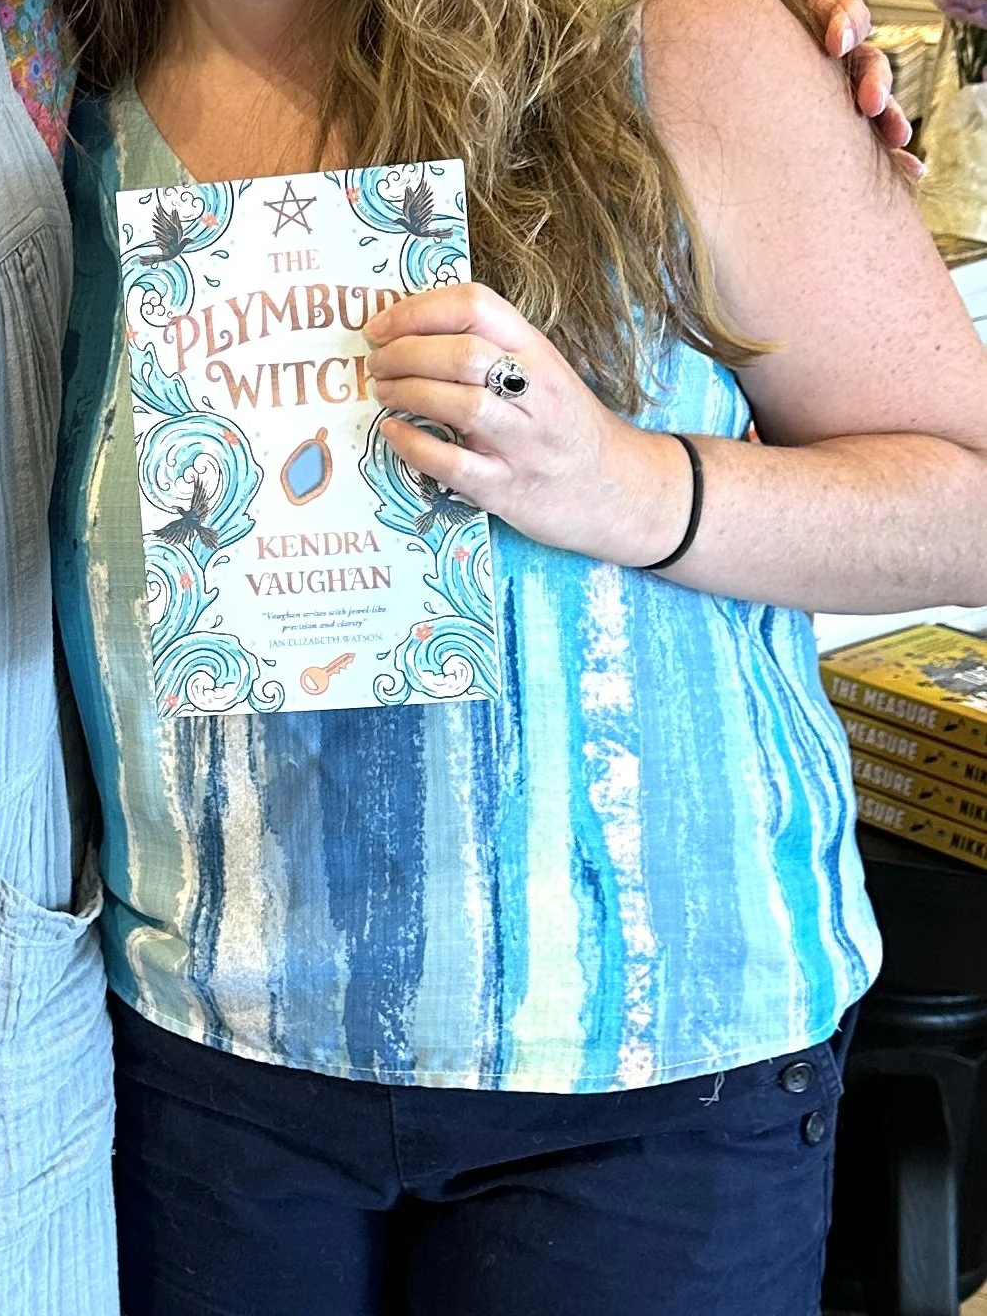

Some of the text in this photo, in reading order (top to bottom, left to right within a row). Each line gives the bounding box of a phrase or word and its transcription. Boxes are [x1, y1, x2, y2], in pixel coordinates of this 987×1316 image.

[268, 249, 320, 273] THE
[256, 530, 381, 560] KENDRA
[244, 565, 392, 596] VAUGHAN
[328, 608, 347, 617] with
[347, 605, 387, 617] jewel-like
[282, 621, 318, 633] precision
[319, 620, 336, 629] and
[269, 633, 383, 649] JAN ELIZABETH WATSON
[832, 676, 938, 730] THE MEASURE
[845, 719, 919, 761] MEASURE
